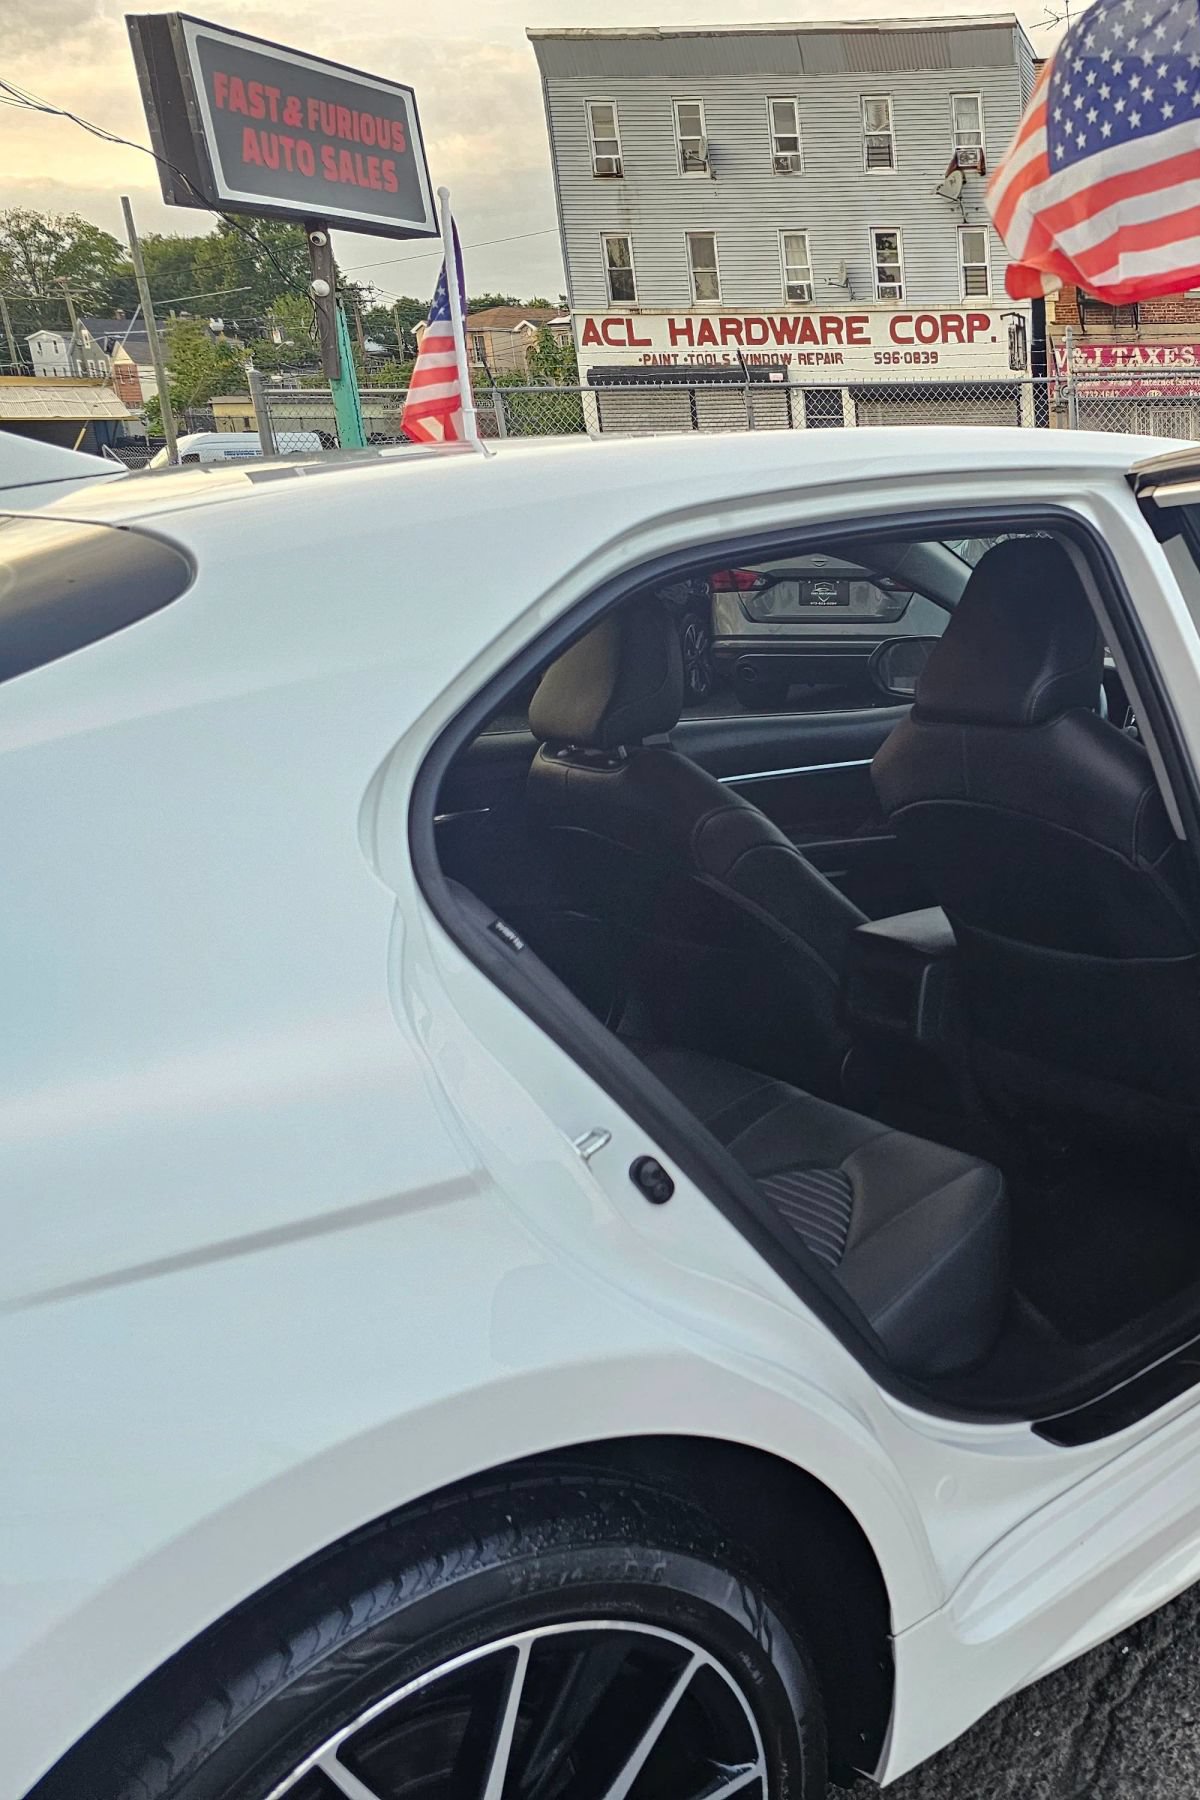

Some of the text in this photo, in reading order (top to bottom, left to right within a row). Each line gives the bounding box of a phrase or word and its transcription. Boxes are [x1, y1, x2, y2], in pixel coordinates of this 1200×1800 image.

[213, 71, 406, 153] FAST & FURIOUS
[242, 127, 399, 193] AUTO SALES
[581, 313, 997, 347] ACL HARDWARE CORP.
[643, 353, 679, 366] PAINT
[687, 353, 730, 366] TOOLS
